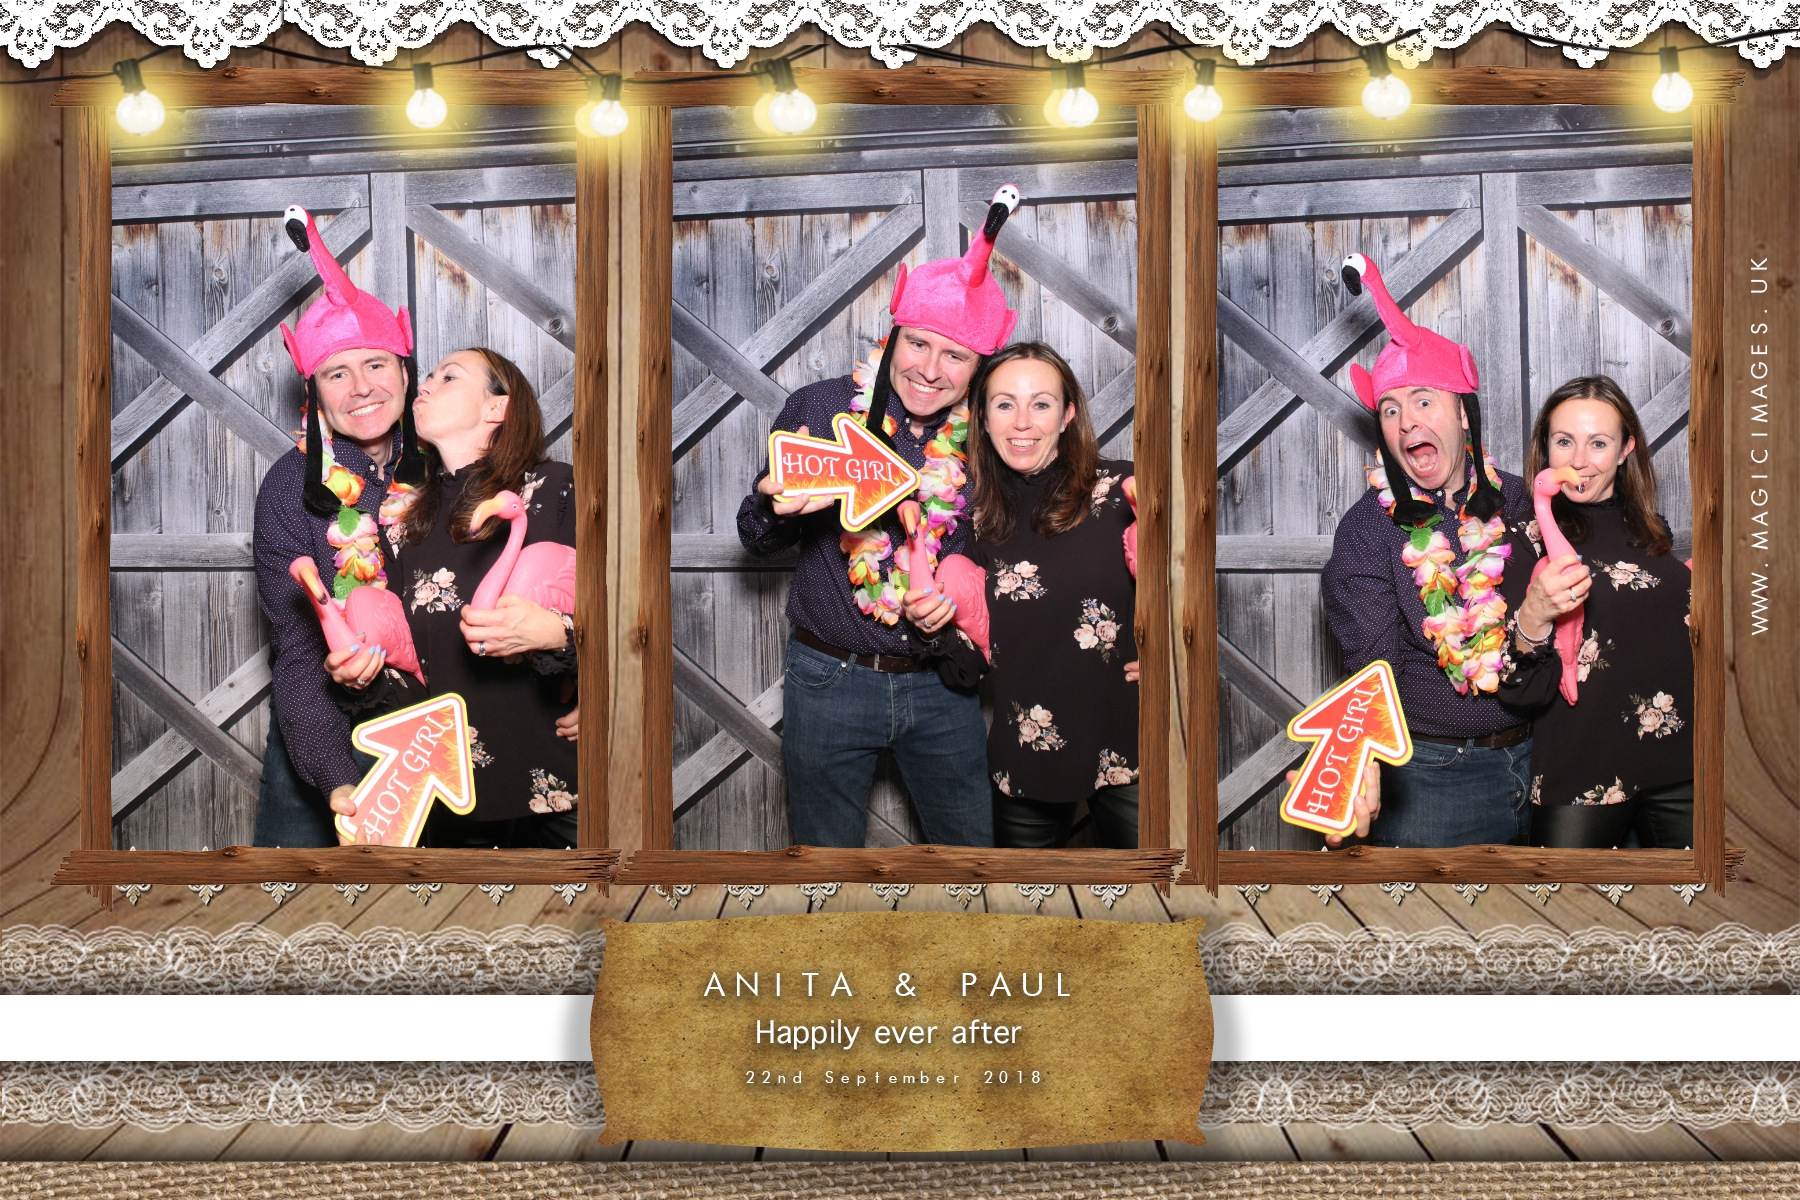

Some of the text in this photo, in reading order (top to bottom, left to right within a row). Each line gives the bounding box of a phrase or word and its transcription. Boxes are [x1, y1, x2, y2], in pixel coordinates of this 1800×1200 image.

[782, 452, 901, 487] HOT GIRL
[362, 714, 456, 838] HOT GIRL
[1306, 683, 1382, 813] HOT GIRL
